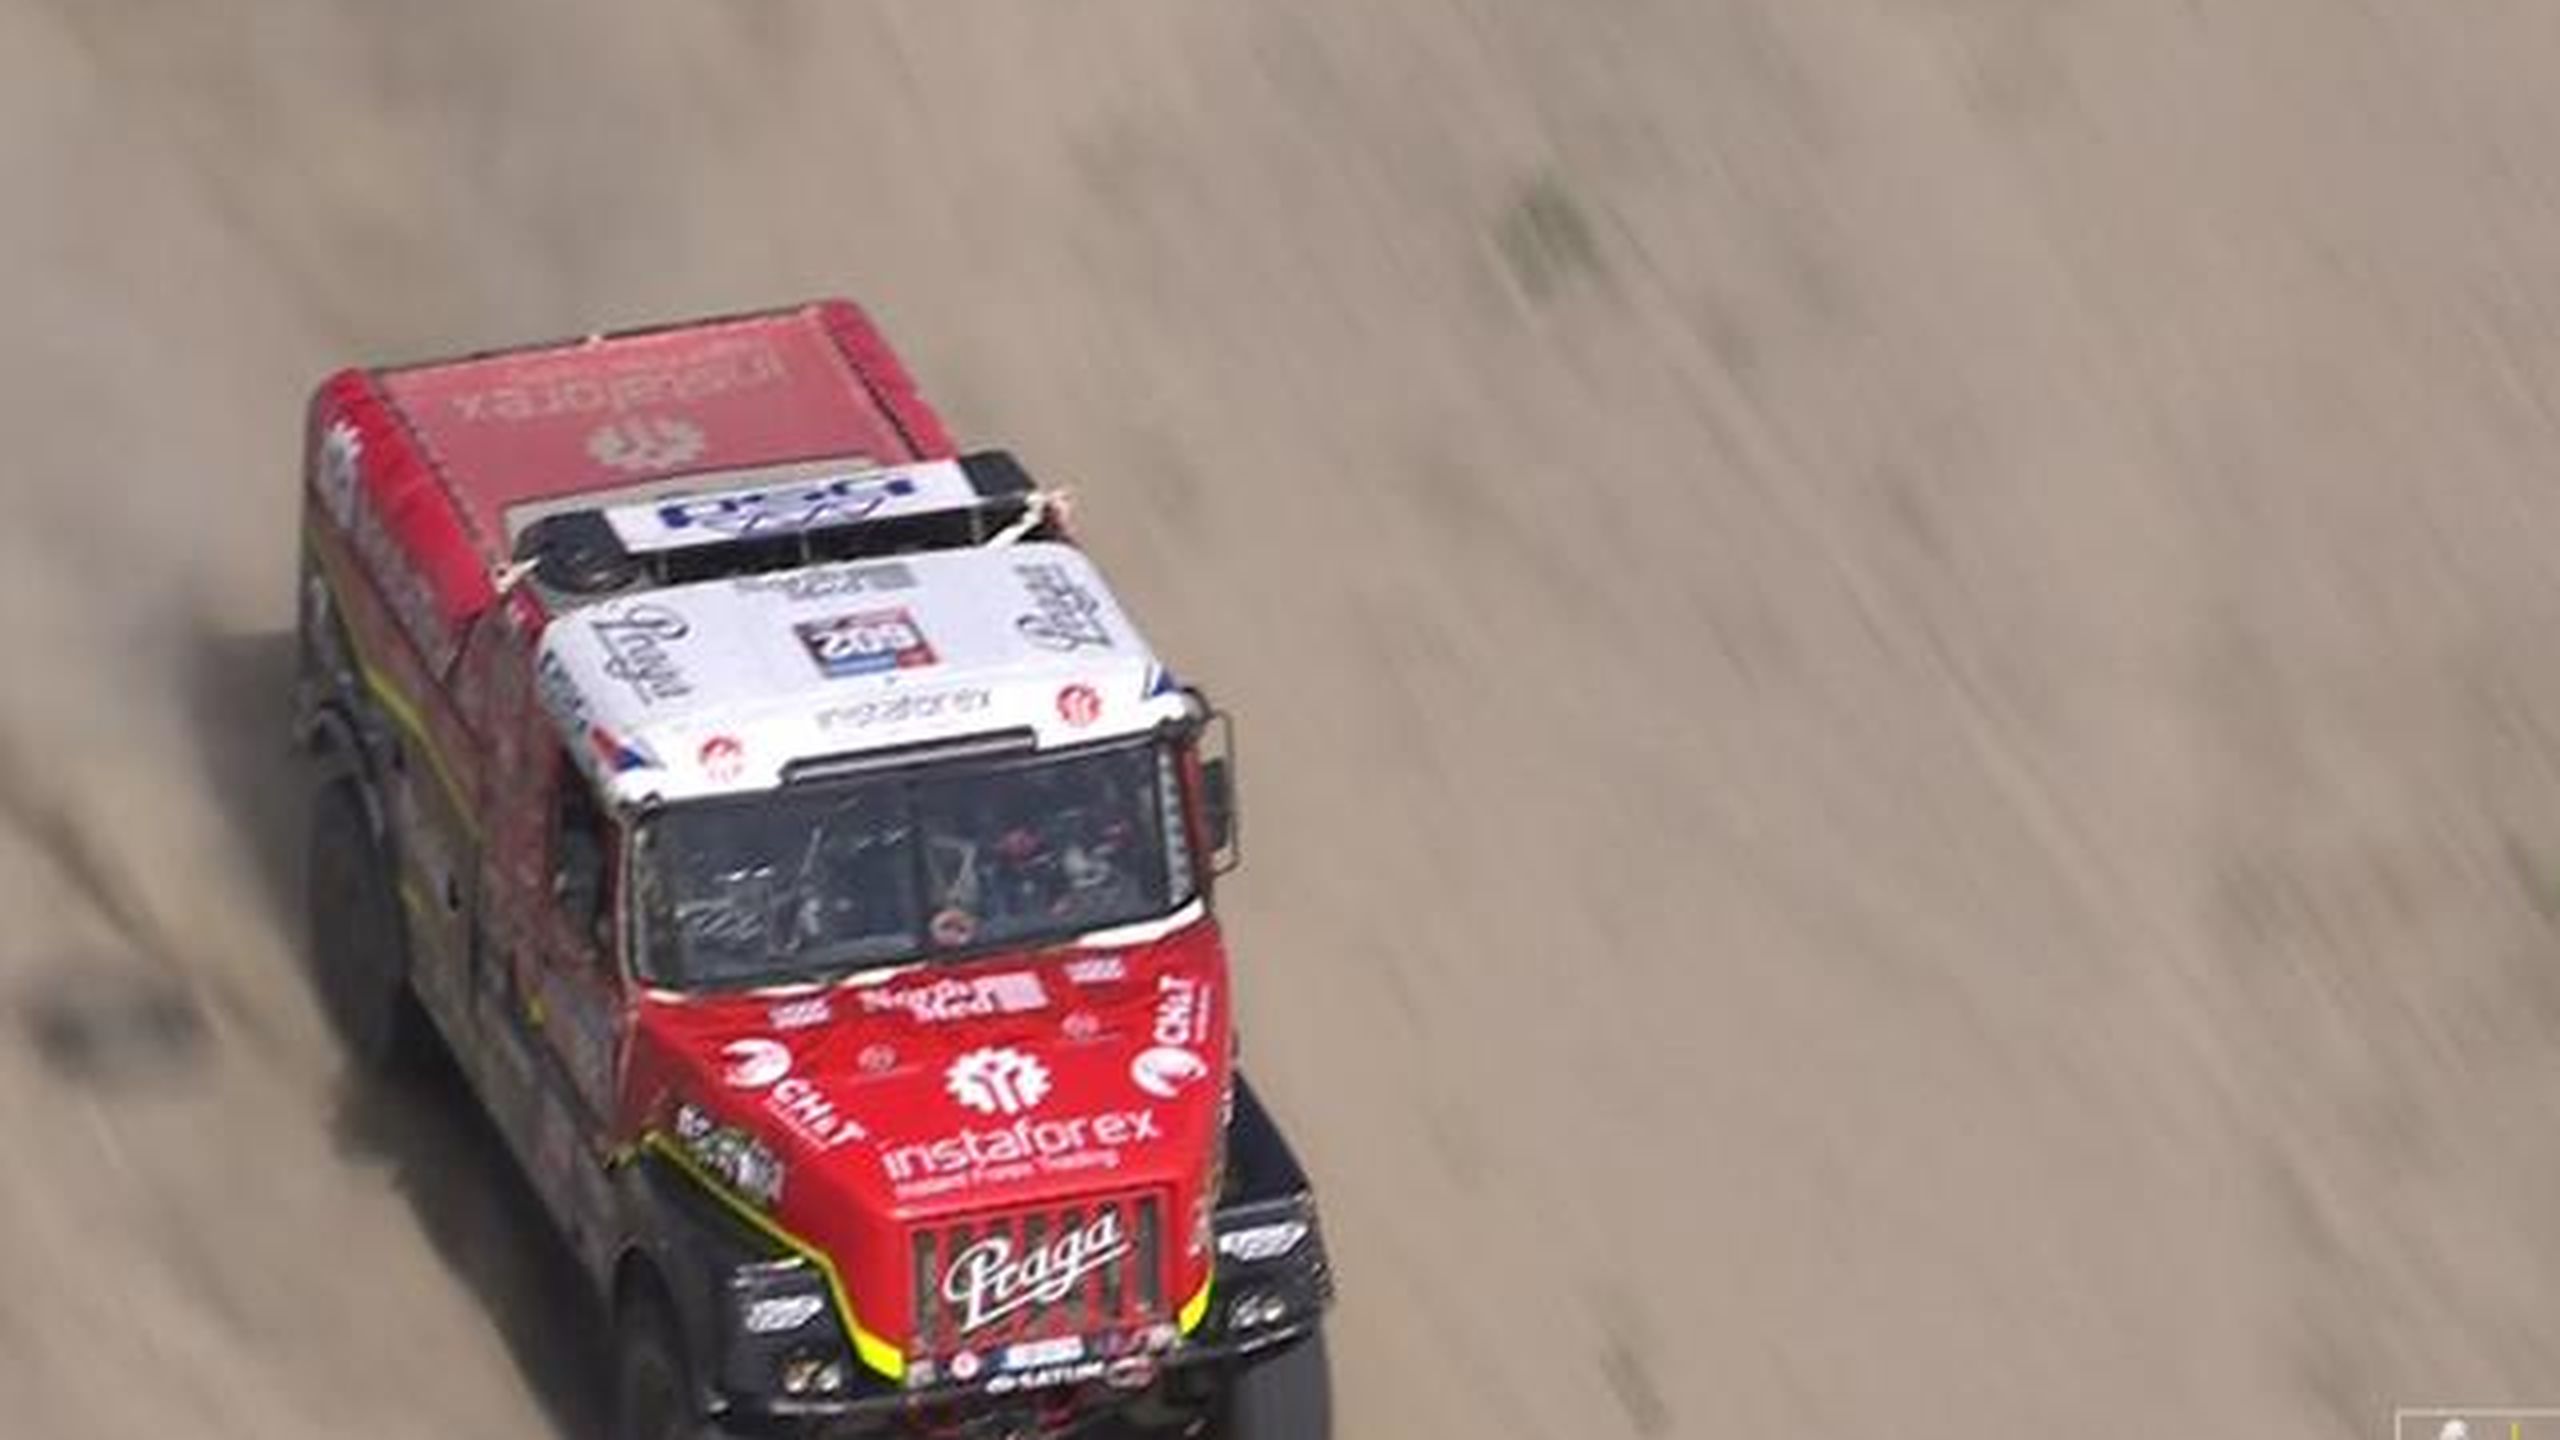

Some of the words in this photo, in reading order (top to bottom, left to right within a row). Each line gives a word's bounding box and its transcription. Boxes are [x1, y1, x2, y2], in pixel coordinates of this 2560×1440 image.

[591, 604, 690, 706] Praga
[881, 1110, 1162, 1181] instaforex
[943, 1211, 1132, 1333] Praga
